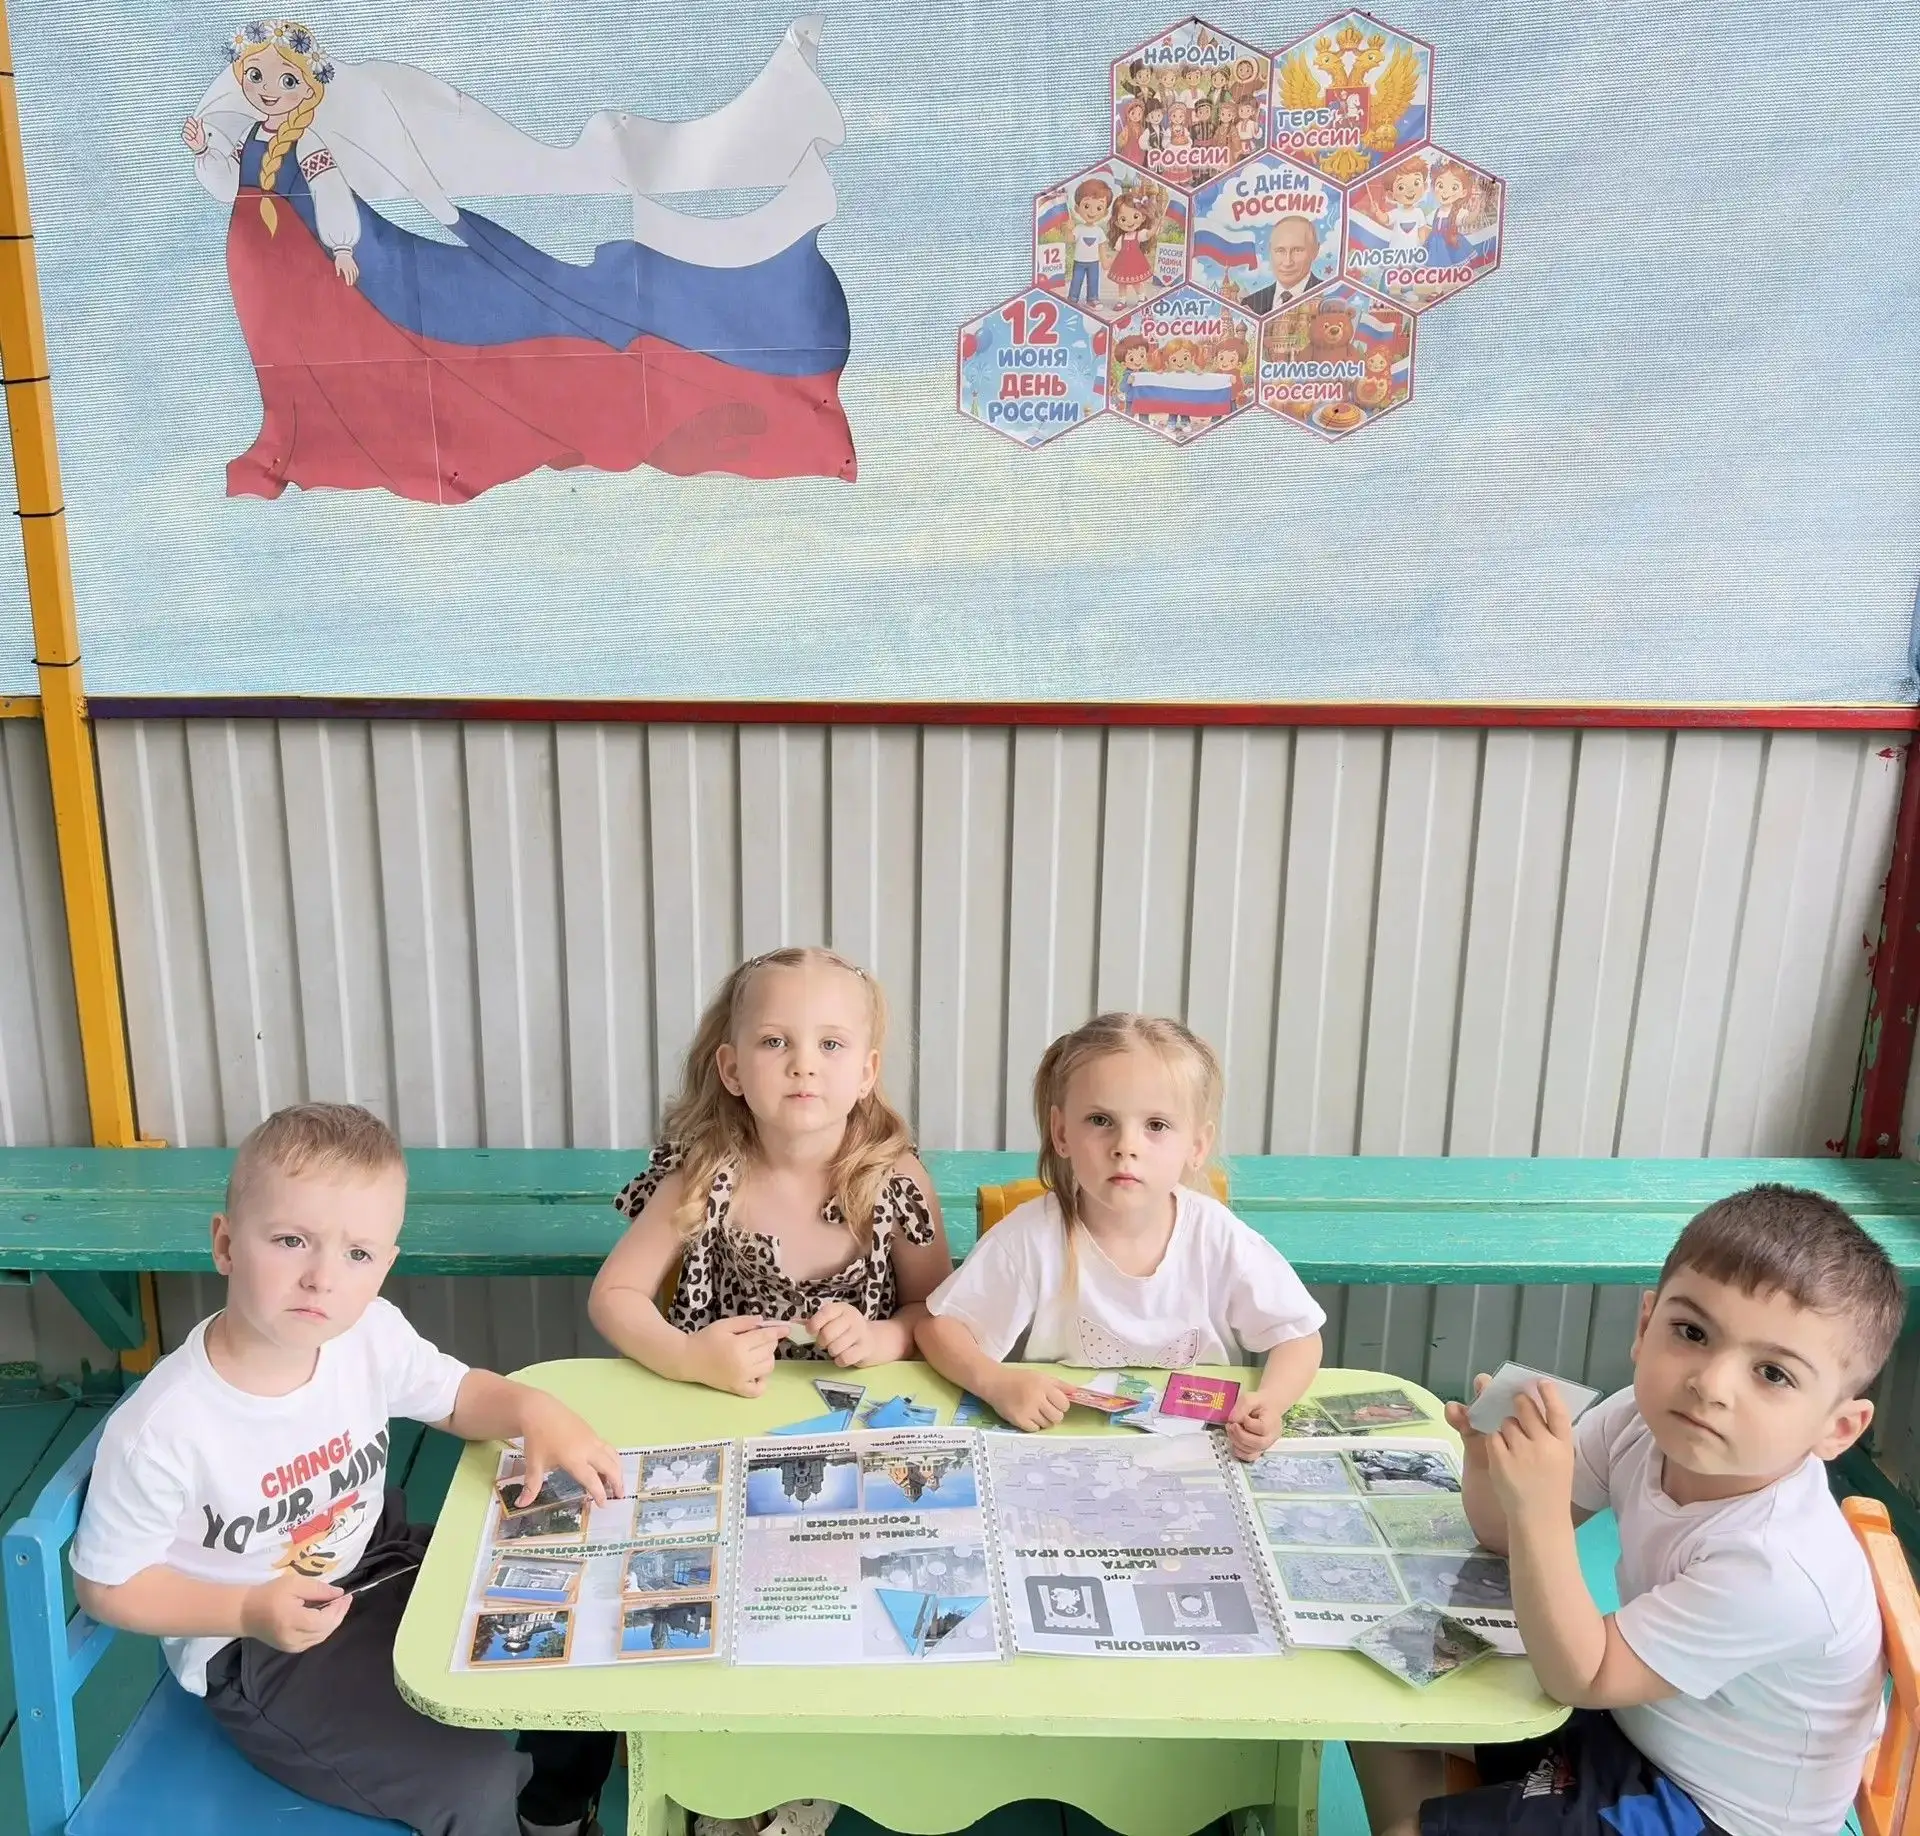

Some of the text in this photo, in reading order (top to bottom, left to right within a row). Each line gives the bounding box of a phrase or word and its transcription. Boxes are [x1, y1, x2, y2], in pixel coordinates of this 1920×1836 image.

[1143, 44, 1236, 65] НАРОДЫ
[1277, 108, 1330, 128] ГЕРБ
[1277, 128, 1360, 149] РОССИИ
[1148, 147, 1230, 167] РОССИИ
[1235, 169, 1310, 196] С ДНЁМ
[1231, 191, 1325, 216] РОССИИ!
[1043, 248, 1061, 265] 12
[1158, 247, 1184, 258] РОССИЯ
[1348, 247, 1428, 267] ЛЮБЛЮ
[1157, 257, 1183, 268] РОДИНА
[1384, 268, 1473, 287] РОССИЮ
[1151, 299, 1211, 318] ФЛАГ
[1000, 299, 1058, 346] 12
[1143, 319, 1222, 338] РОССИИ
[998, 348, 1068, 369] ИЮНЯ
[1261, 360, 1365, 380] СИМВОЛЫ
[998, 373, 1066, 398] ДЕНЬ
[1263, 383, 1343, 401] РОССИИ
[988, 402, 1079, 423] РОССИИ
[260, 1429, 353, 1499] CHANGE
[202, 1424, 390, 1554] YOUR MIN
[805, 1514, 921, 1528] Георгиевска
[789, 1528, 940, 1543] Храмы и церкви
[1014, 1546, 1234, 1558] СТАВРОПОЛЬСКОГО КРАЯ
[1101, 1559, 1157, 1570] КАРТА
[1103, 1573, 1132, 1582] герб
[1208, 1572, 1241, 1582] флаг
[1094, 1639, 1201, 1652] СИМВОЛЫ
